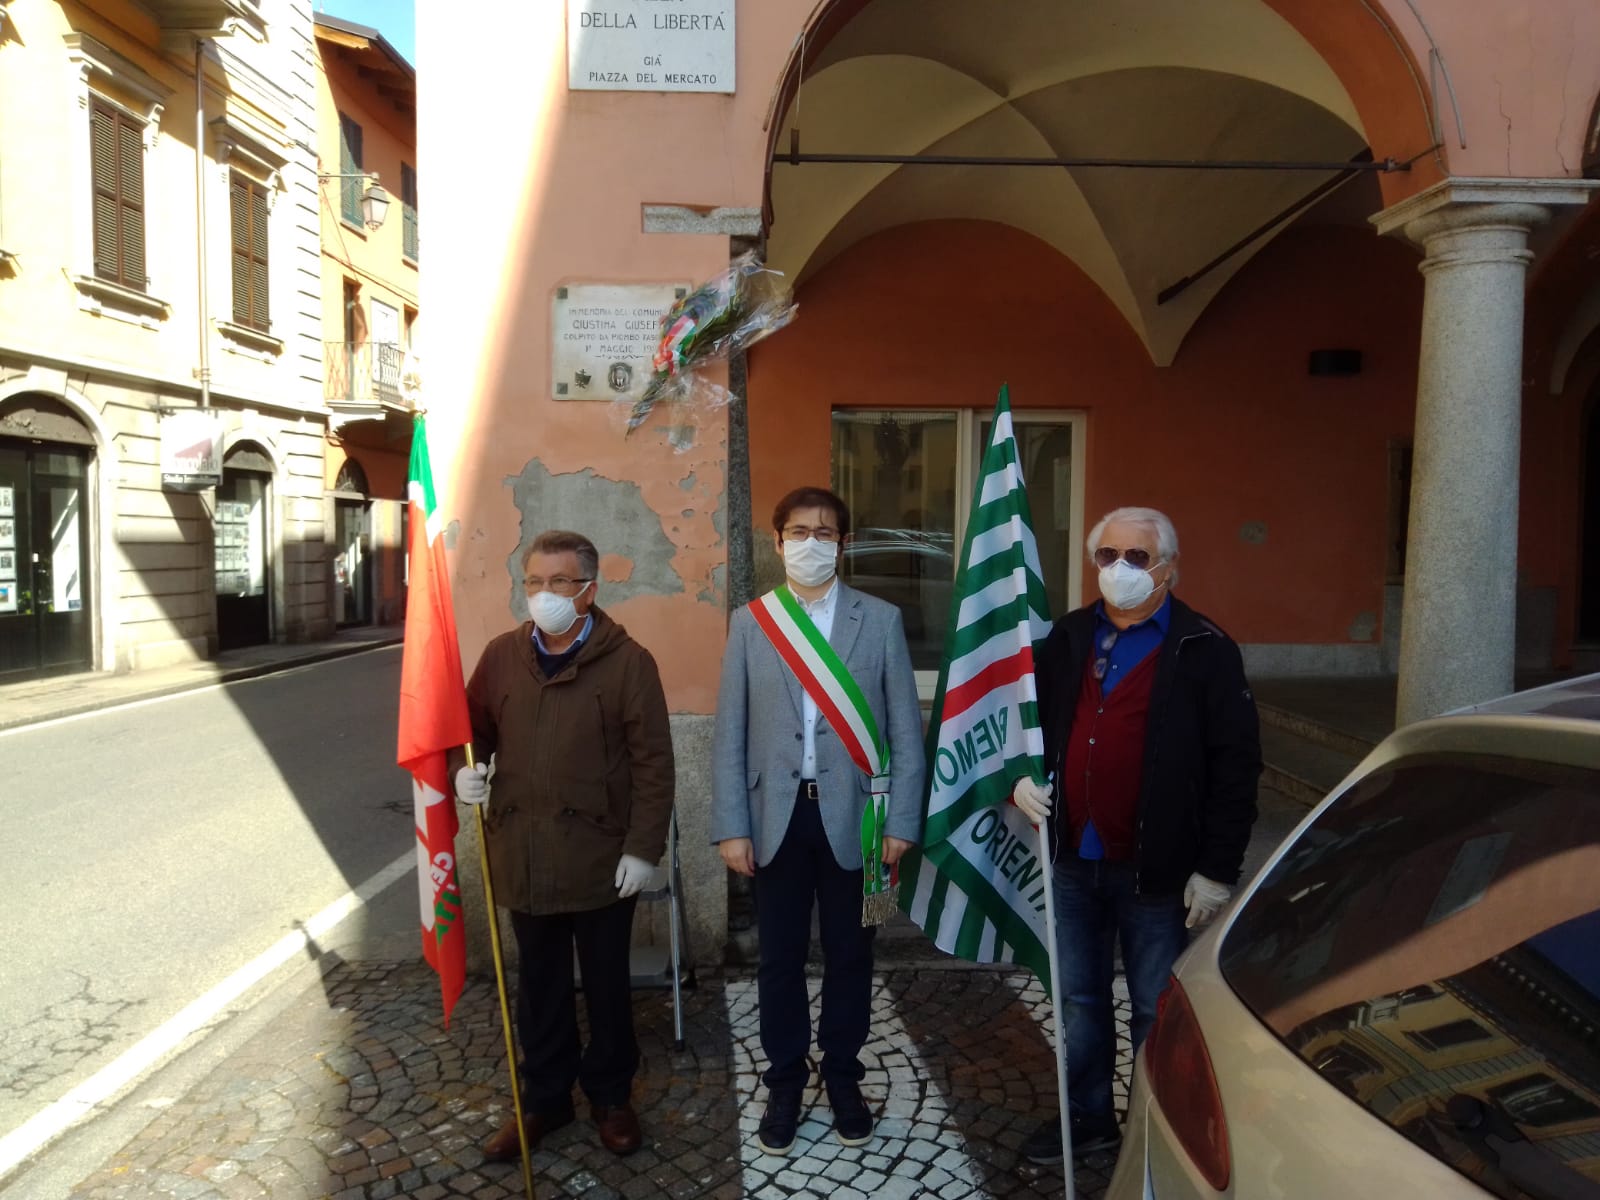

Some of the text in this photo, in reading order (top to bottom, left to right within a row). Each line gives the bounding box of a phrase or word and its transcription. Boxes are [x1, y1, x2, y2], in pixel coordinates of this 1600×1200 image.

[580, 12, 637, 29] DELLA
[589, 72, 717, 84] PIAZZA DEL MERCATO
[625, 320, 659, 330] GIUSEP
[600, 345, 633, 353] MAGGIO
[971, 809, 1046, 912] ORIEN
